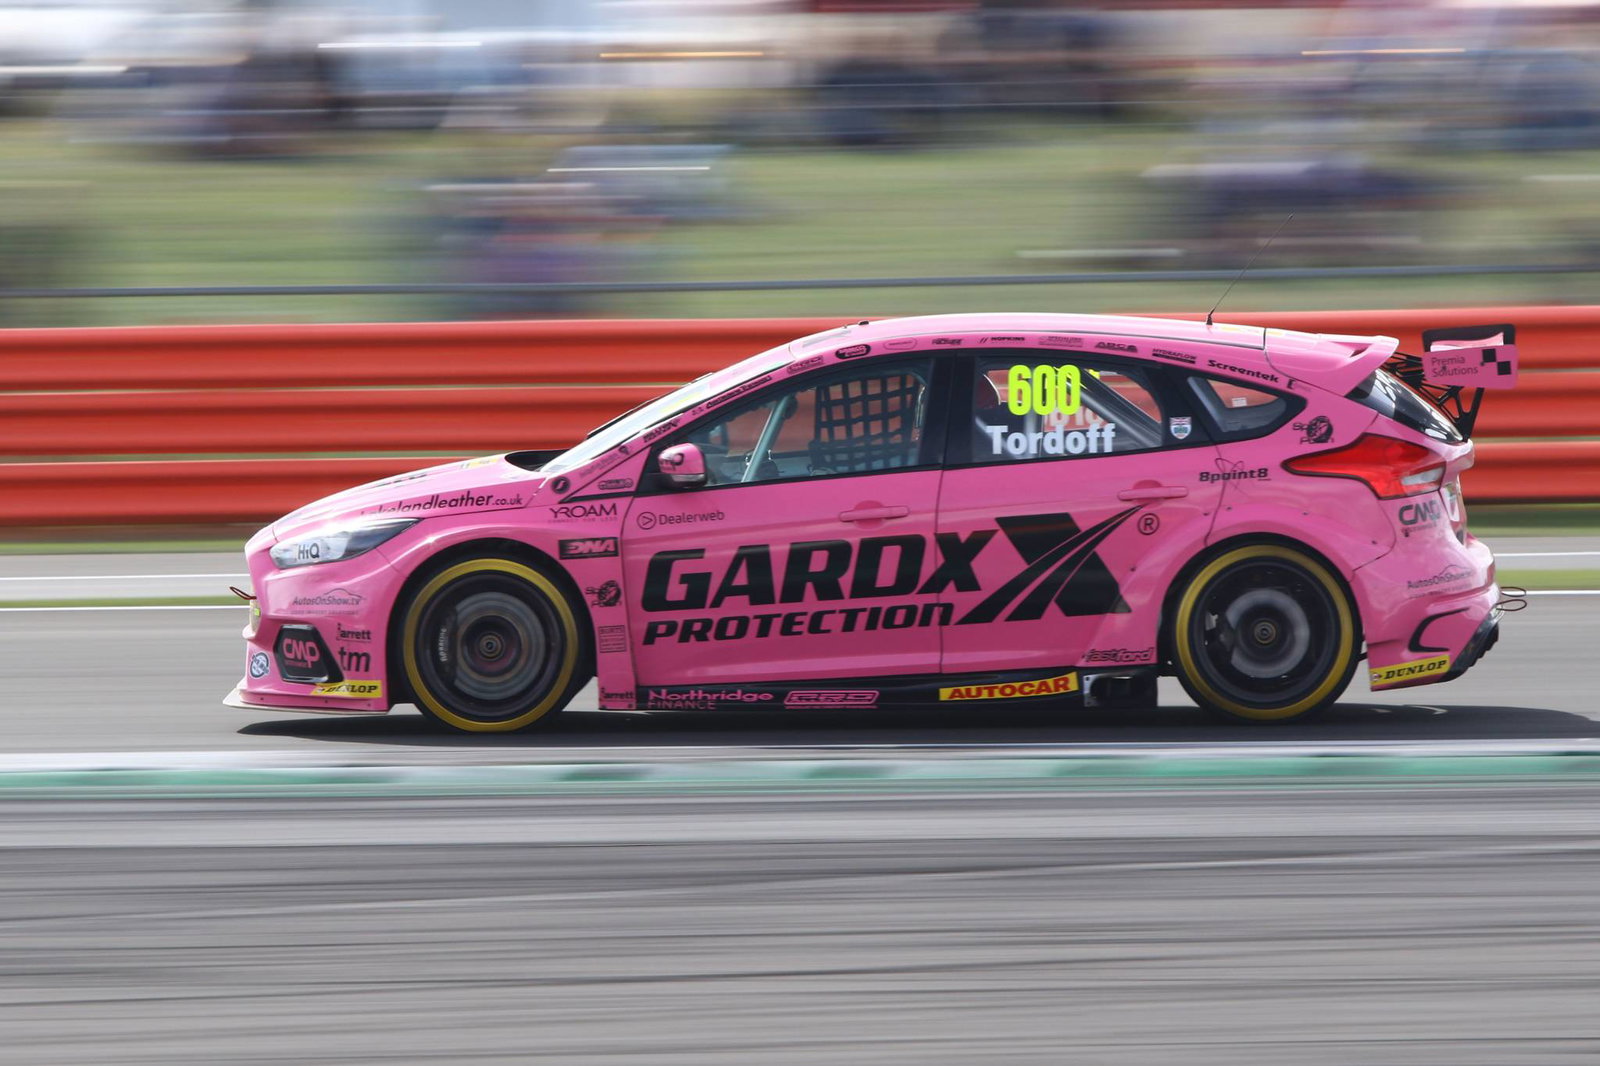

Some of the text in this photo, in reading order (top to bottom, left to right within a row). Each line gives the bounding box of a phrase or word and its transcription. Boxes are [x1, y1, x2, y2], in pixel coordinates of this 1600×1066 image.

[1208, 359, 1279, 383] Screentek
[1431, 357, 1465, 367] Premia
[1432, 366, 1478, 378] Solutions
[1008, 364, 1081, 415] 600
[986, 422, 1116, 455] Tordoff
[549, 503, 617, 518] YROAM
[659, 510, 725, 525] Dealerweb
[298, 542, 320, 560] HiQ
[338, 646, 371, 673] tm
[1384, 659, 1447, 680] DUNLOP
[648, 689, 774, 702] Northridge
[948, 677, 1071, 700] AUTOCAR
[648, 701, 717, 709] FINANCE
